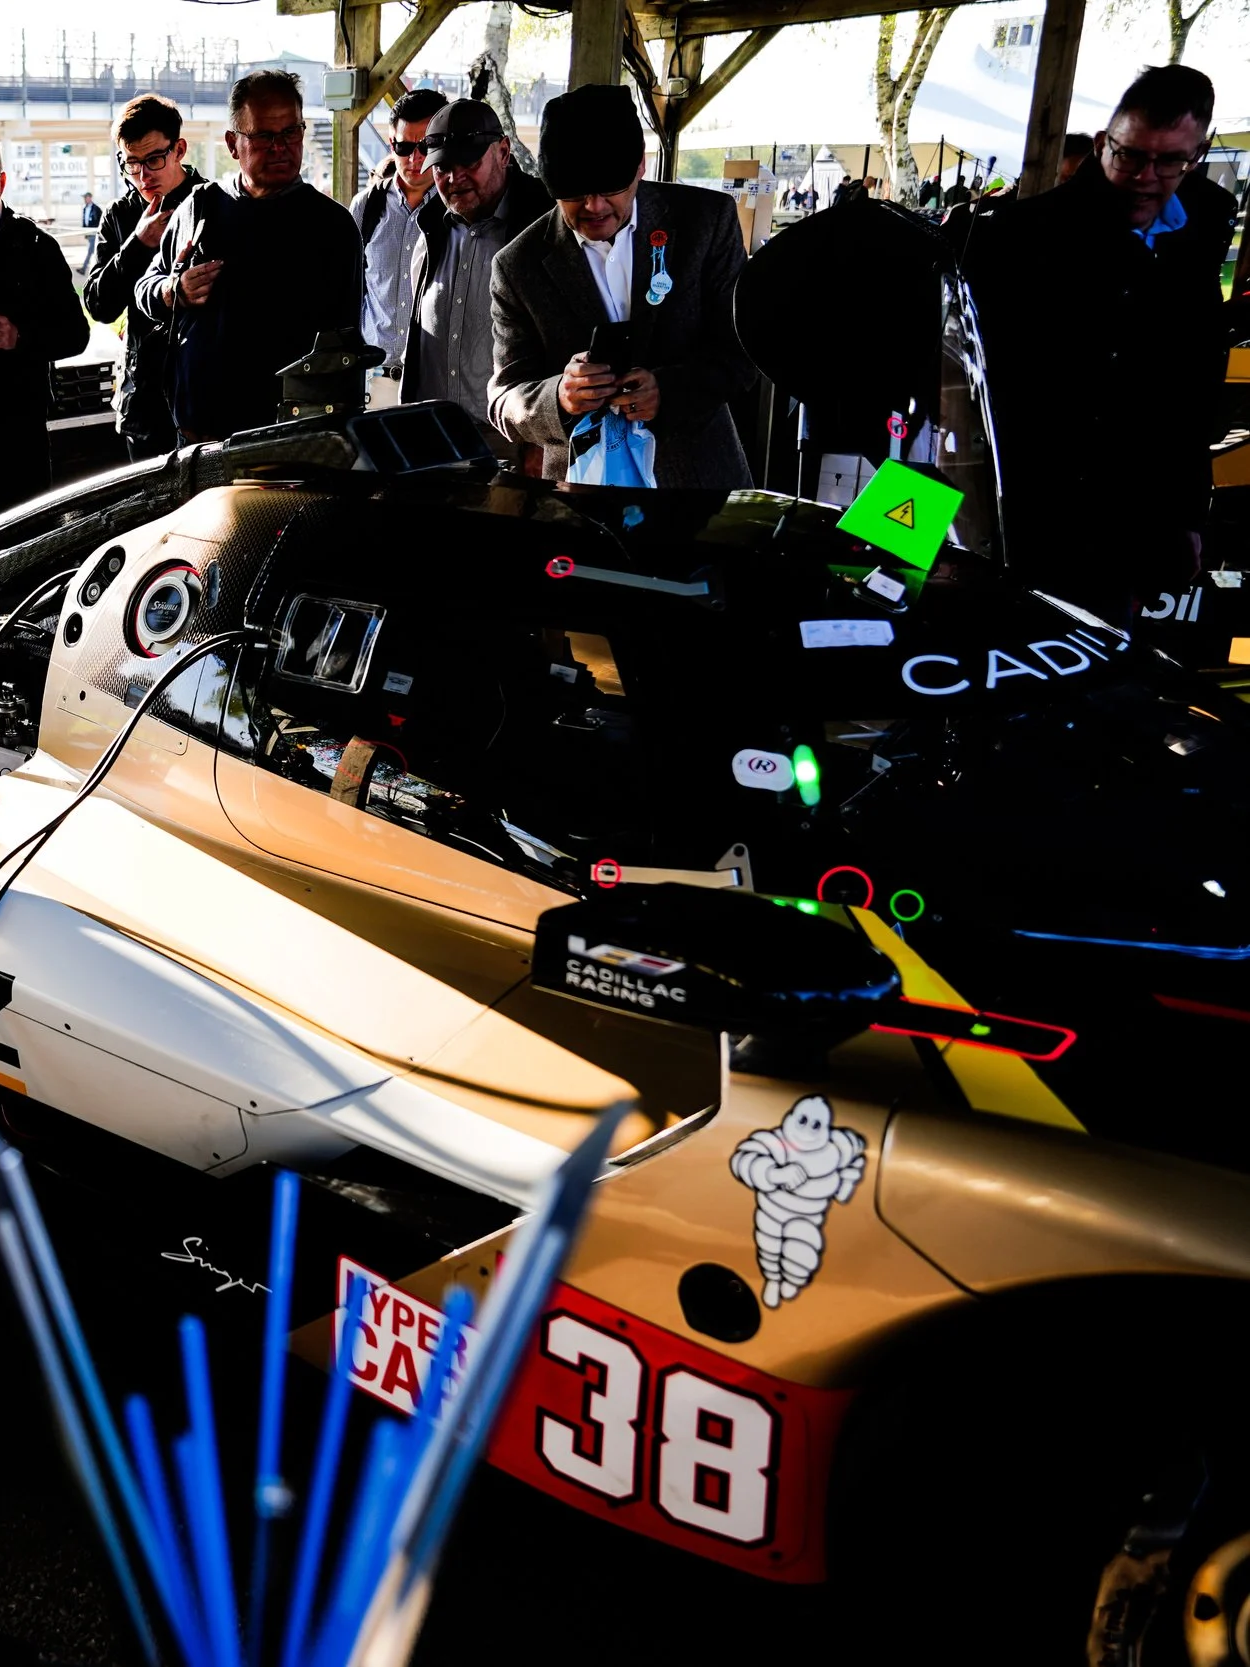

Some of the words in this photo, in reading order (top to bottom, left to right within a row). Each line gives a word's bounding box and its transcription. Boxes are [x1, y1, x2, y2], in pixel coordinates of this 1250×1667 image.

[565, 972, 656, 1008] RACING
[566, 958, 687, 1002] CADILLAC
[342, 1317, 462, 1418] CA
[538, 1310, 780, 1546] 38
